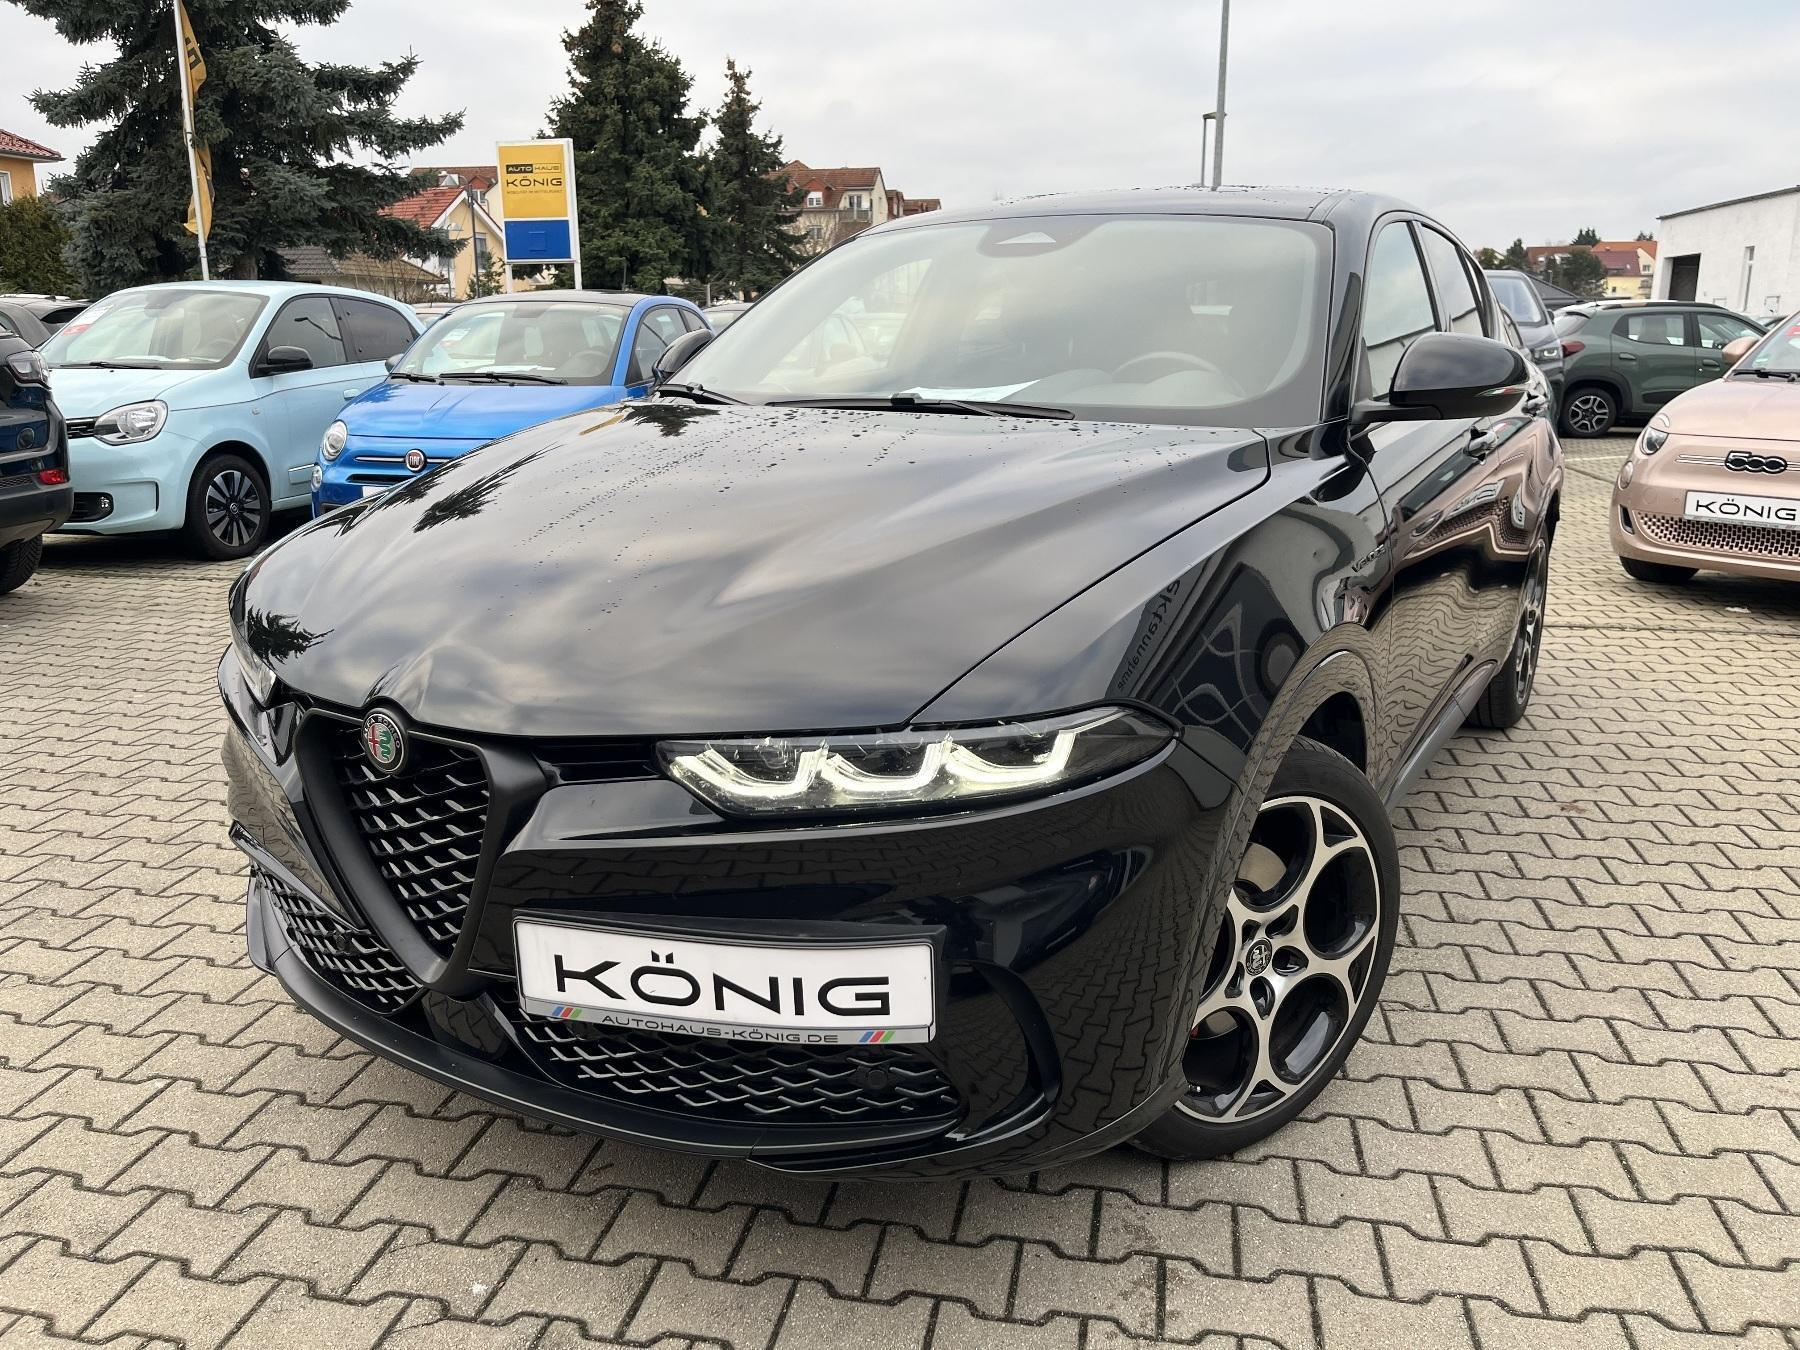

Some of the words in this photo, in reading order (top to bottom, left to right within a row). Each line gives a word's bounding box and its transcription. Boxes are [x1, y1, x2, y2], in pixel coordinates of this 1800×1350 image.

[506, 175, 562, 187] KÖNIG
[1725, 450, 1788, 474] 500
[1695, 498, 1797, 522] KÖNIG
[553, 949, 890, 1017] KÖNIG
[601, 1014, 839, 1044] AUTOHAUS-KÖNIG.DE
